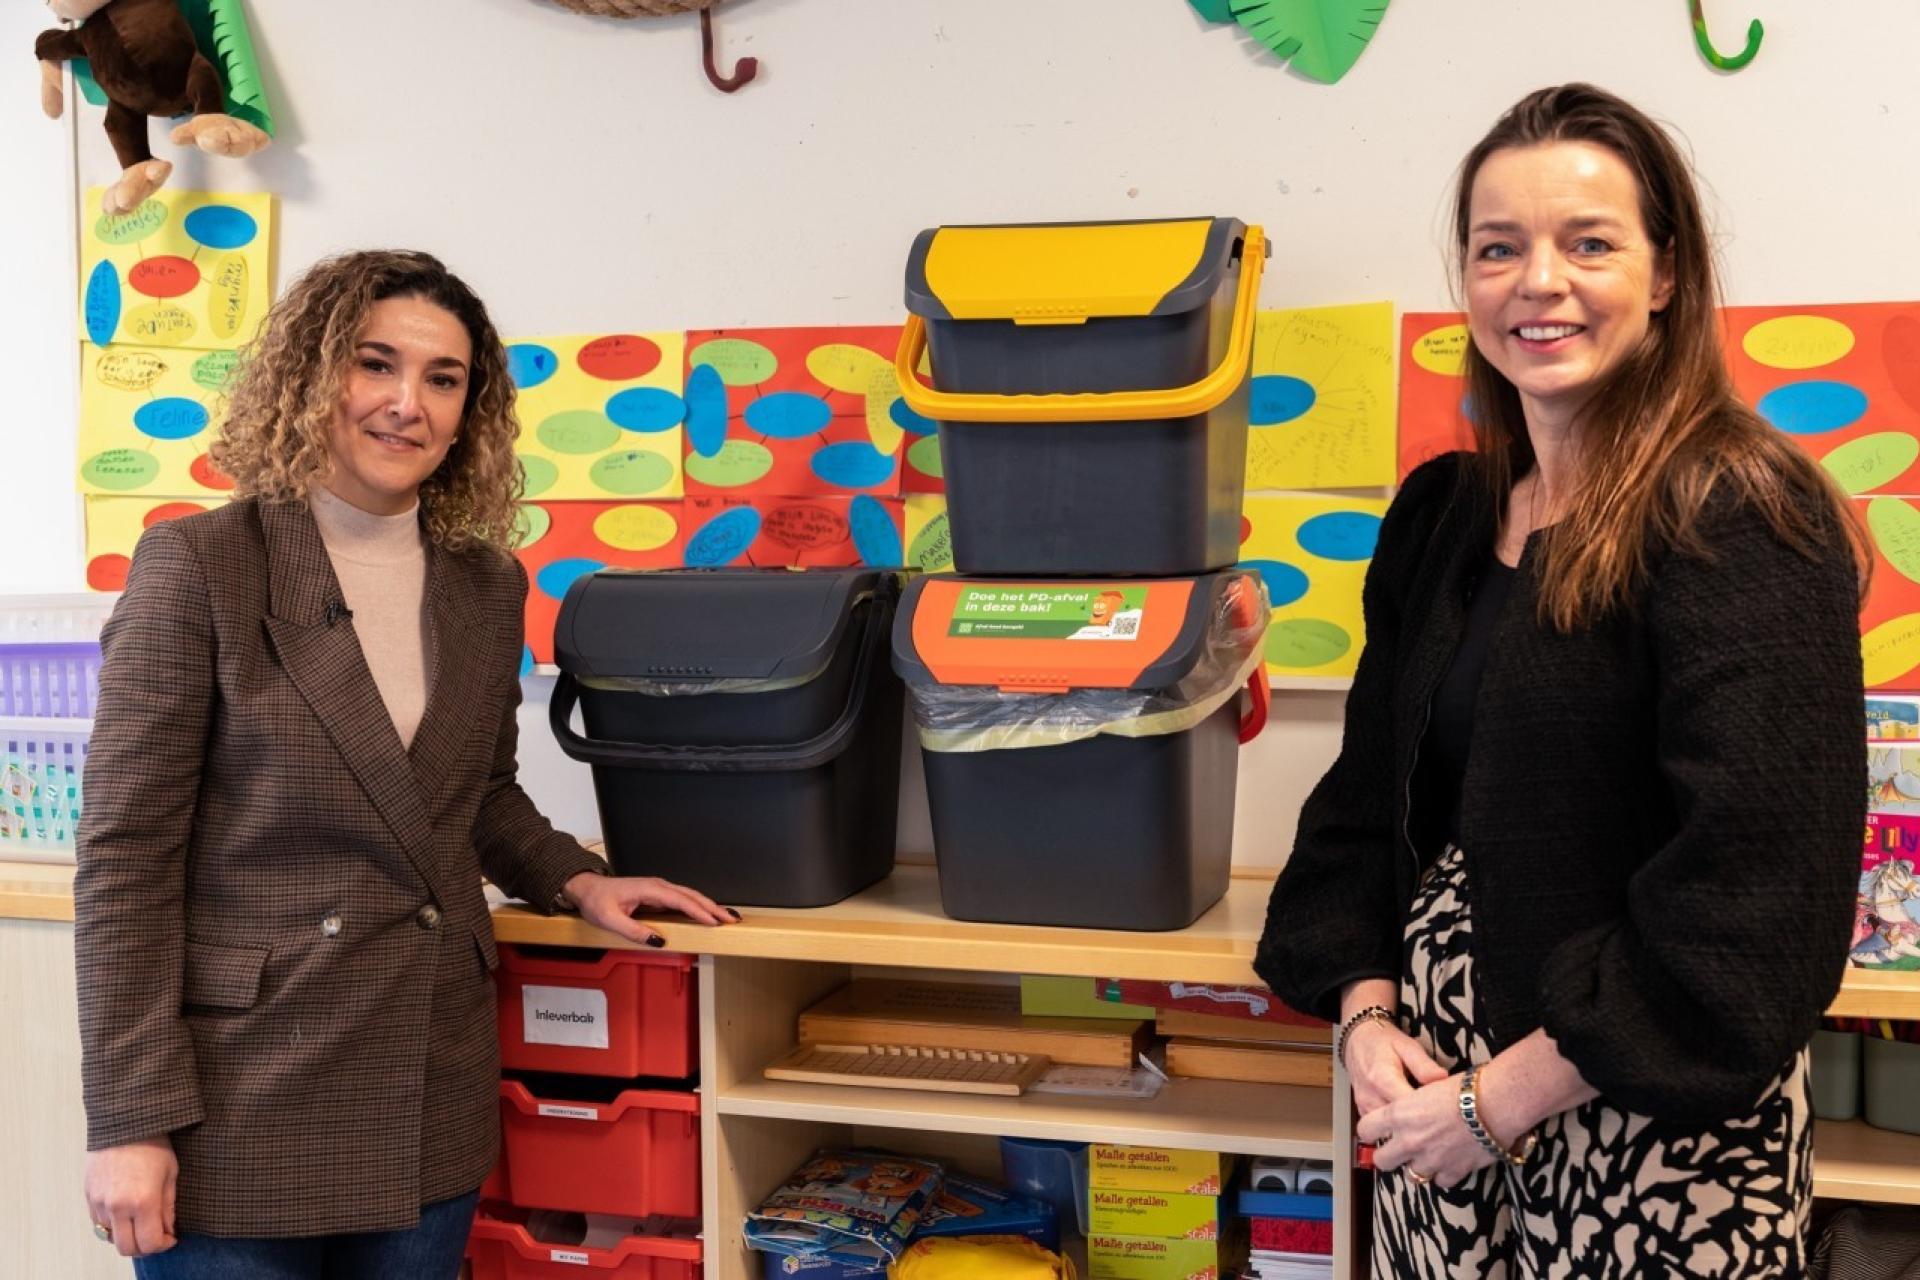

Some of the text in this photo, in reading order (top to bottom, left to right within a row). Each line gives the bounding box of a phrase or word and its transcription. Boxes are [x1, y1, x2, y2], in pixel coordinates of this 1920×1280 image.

[150, 408, 205, 429] Feline
[968, 591, 1089, 602] Doe het PD-afval
[965, 601, 1052, 613] in deze bak!
[535, 1008, 594, 1024] Inleverbak
[1128, 1150, 1170, 1164] getallen
[1189, 1184, 1218, 1195] scala
[1126, 1194, 1168, 1208] getallen
[1186, 1229, 1216, 1240] scala
[1125, 1238, 1167, 1252] getallen
